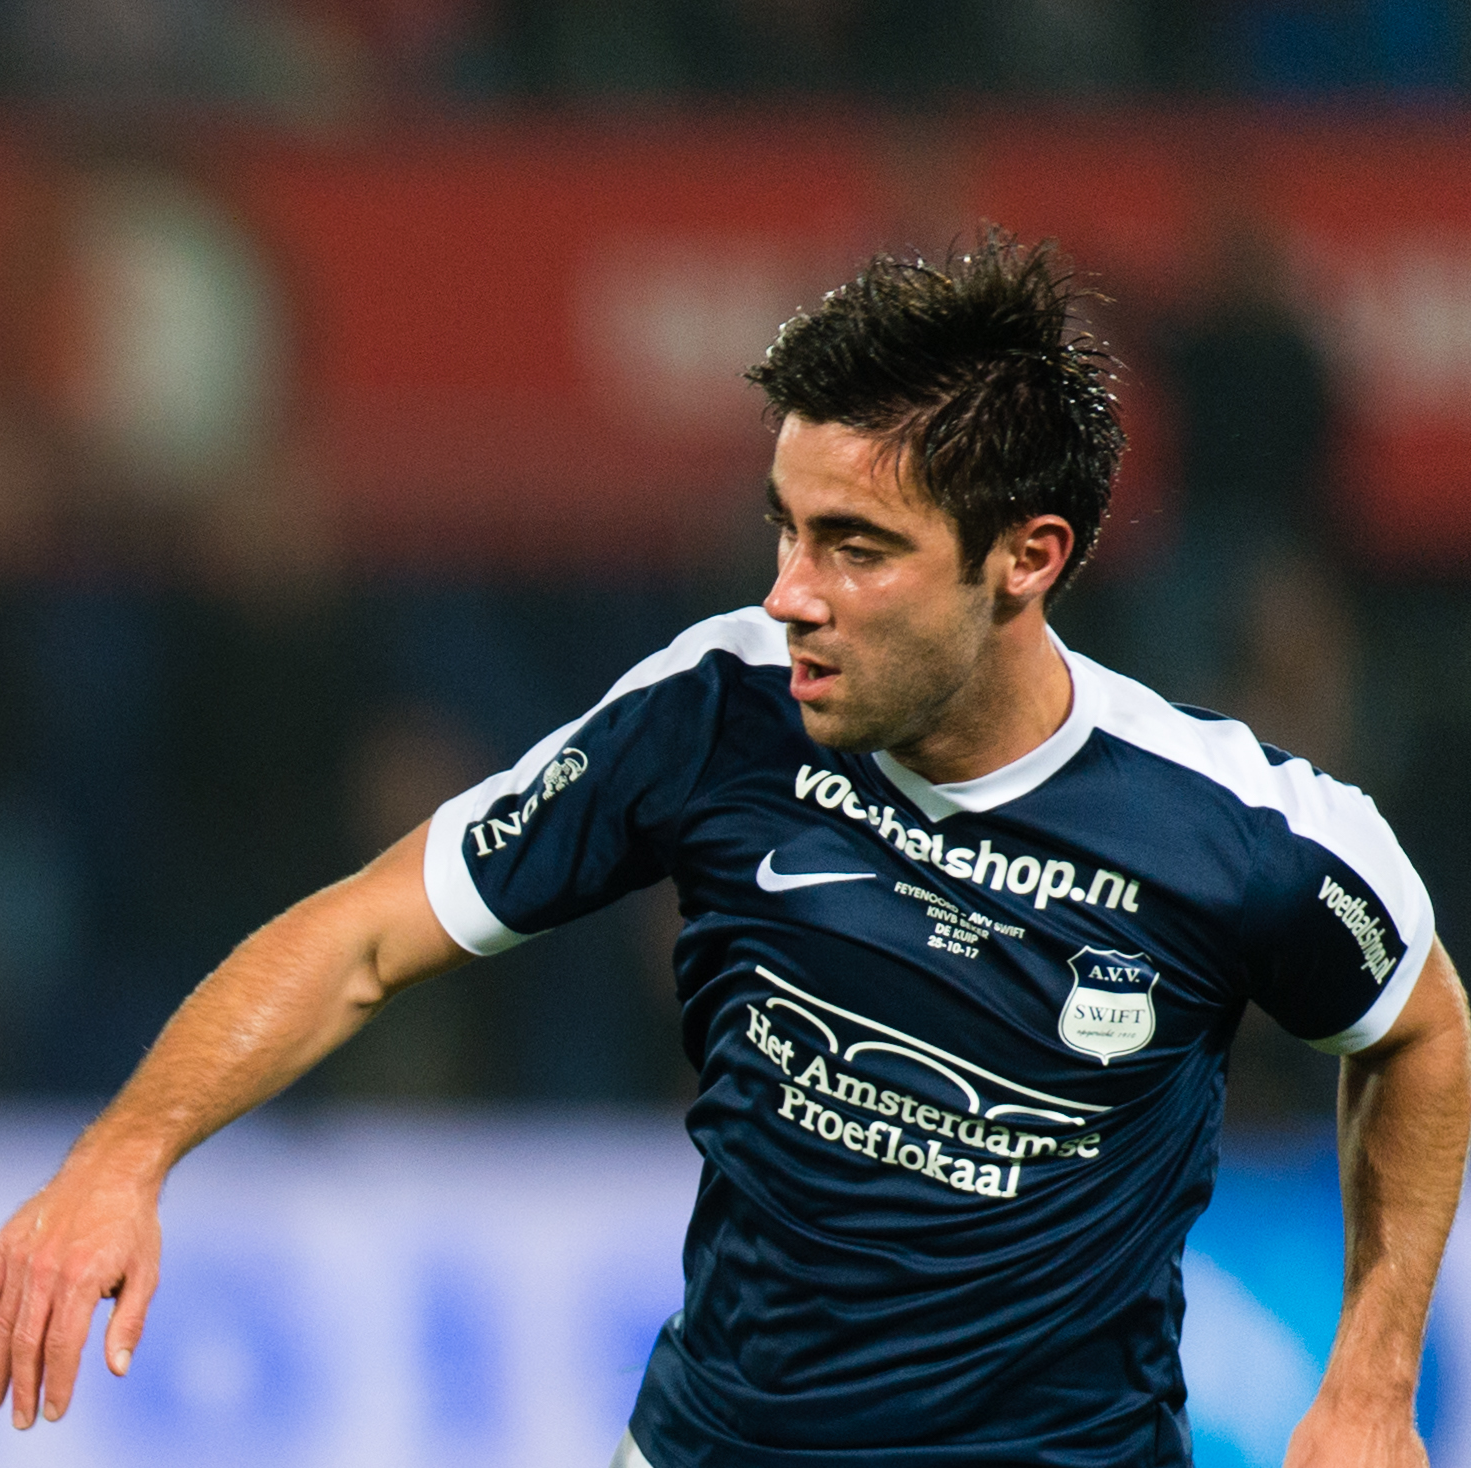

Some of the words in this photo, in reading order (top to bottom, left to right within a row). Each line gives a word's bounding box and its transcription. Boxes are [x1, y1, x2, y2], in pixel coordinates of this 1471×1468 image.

[926, 905, 958, 924] KNVB
[934, 922, 952, 937] DE
[952, 928, 979, 944] KUIP
[994, 922, 1025, 939] SWIFT
[1088, 965, 1141, 983] A.V.V.
[1074, 1003, 1146, 1024] SWIFT
[745, 1003, 795, 1075] Het
[794, 1055, 1101, 1160] Amsterdamse
[777, 1083, 1020, 1198] Proeflokaal
